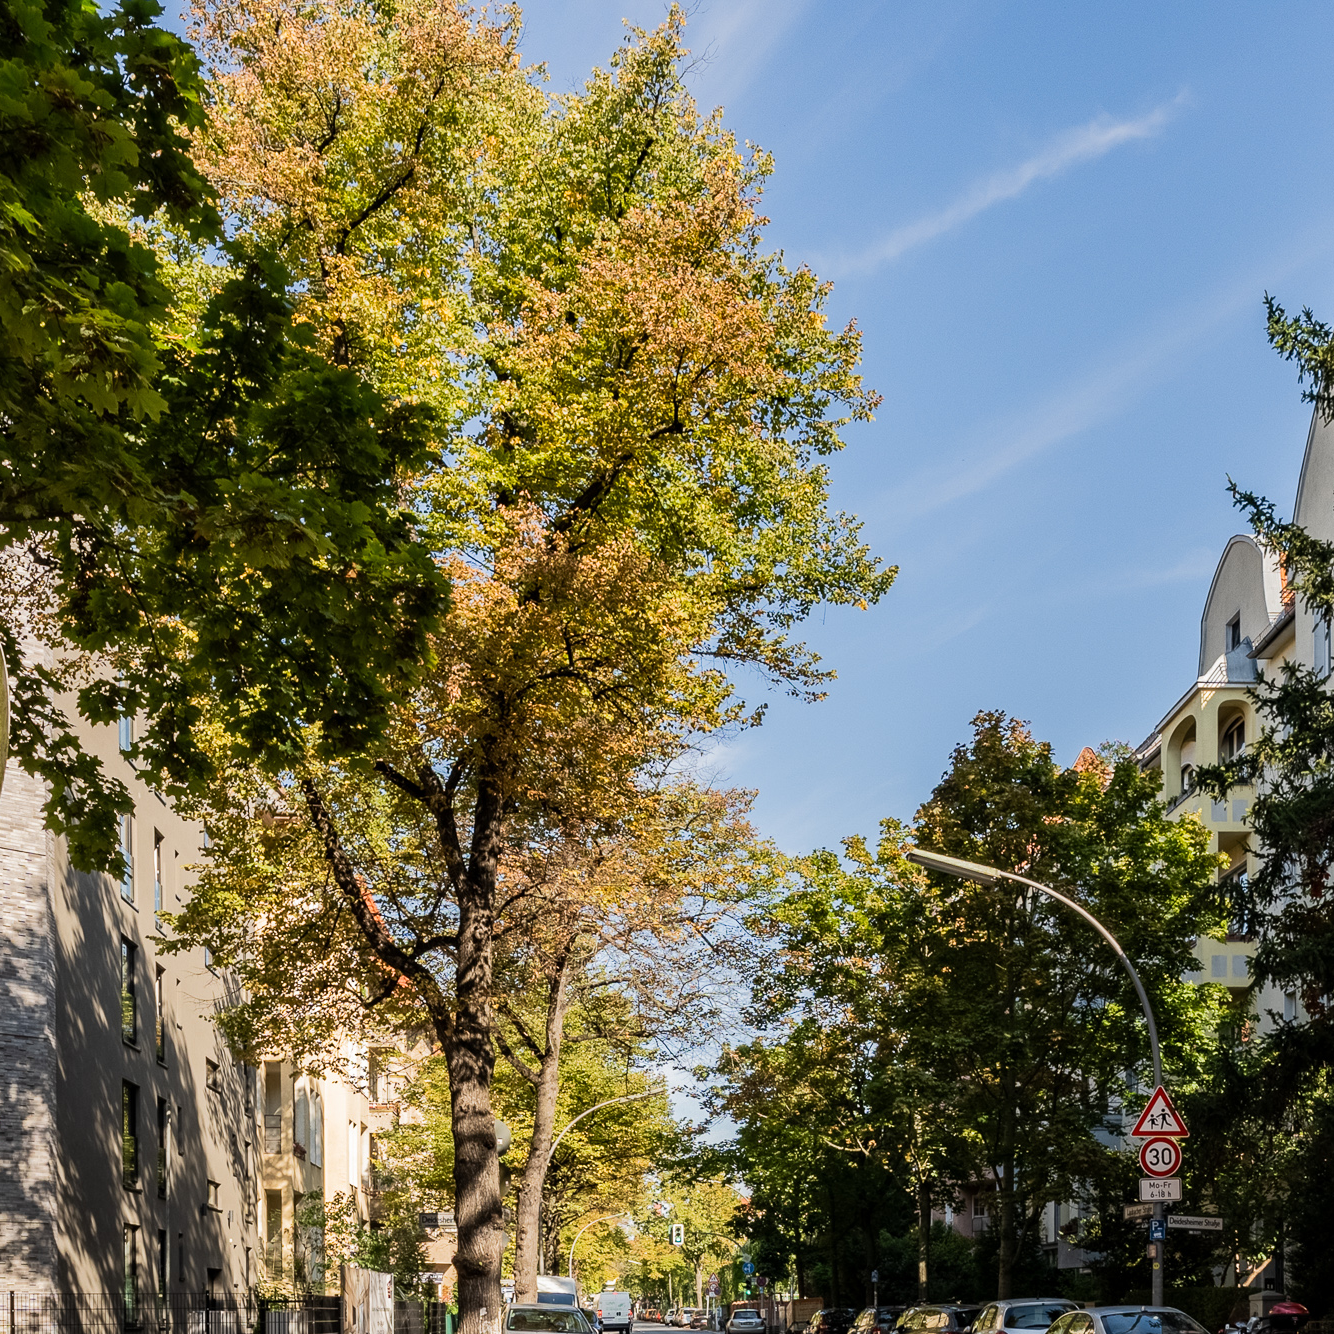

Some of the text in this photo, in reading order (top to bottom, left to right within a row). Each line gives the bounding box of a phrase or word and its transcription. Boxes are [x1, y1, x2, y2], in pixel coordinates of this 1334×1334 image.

[1149, 1148, 1172, 1166] 30
[1150, 1190, 1172, 1198] 6-18 h
[1152, 1221, 1159, 1231] P
[1169, 1216, 1220, 1229] Deidesheimer Straße
